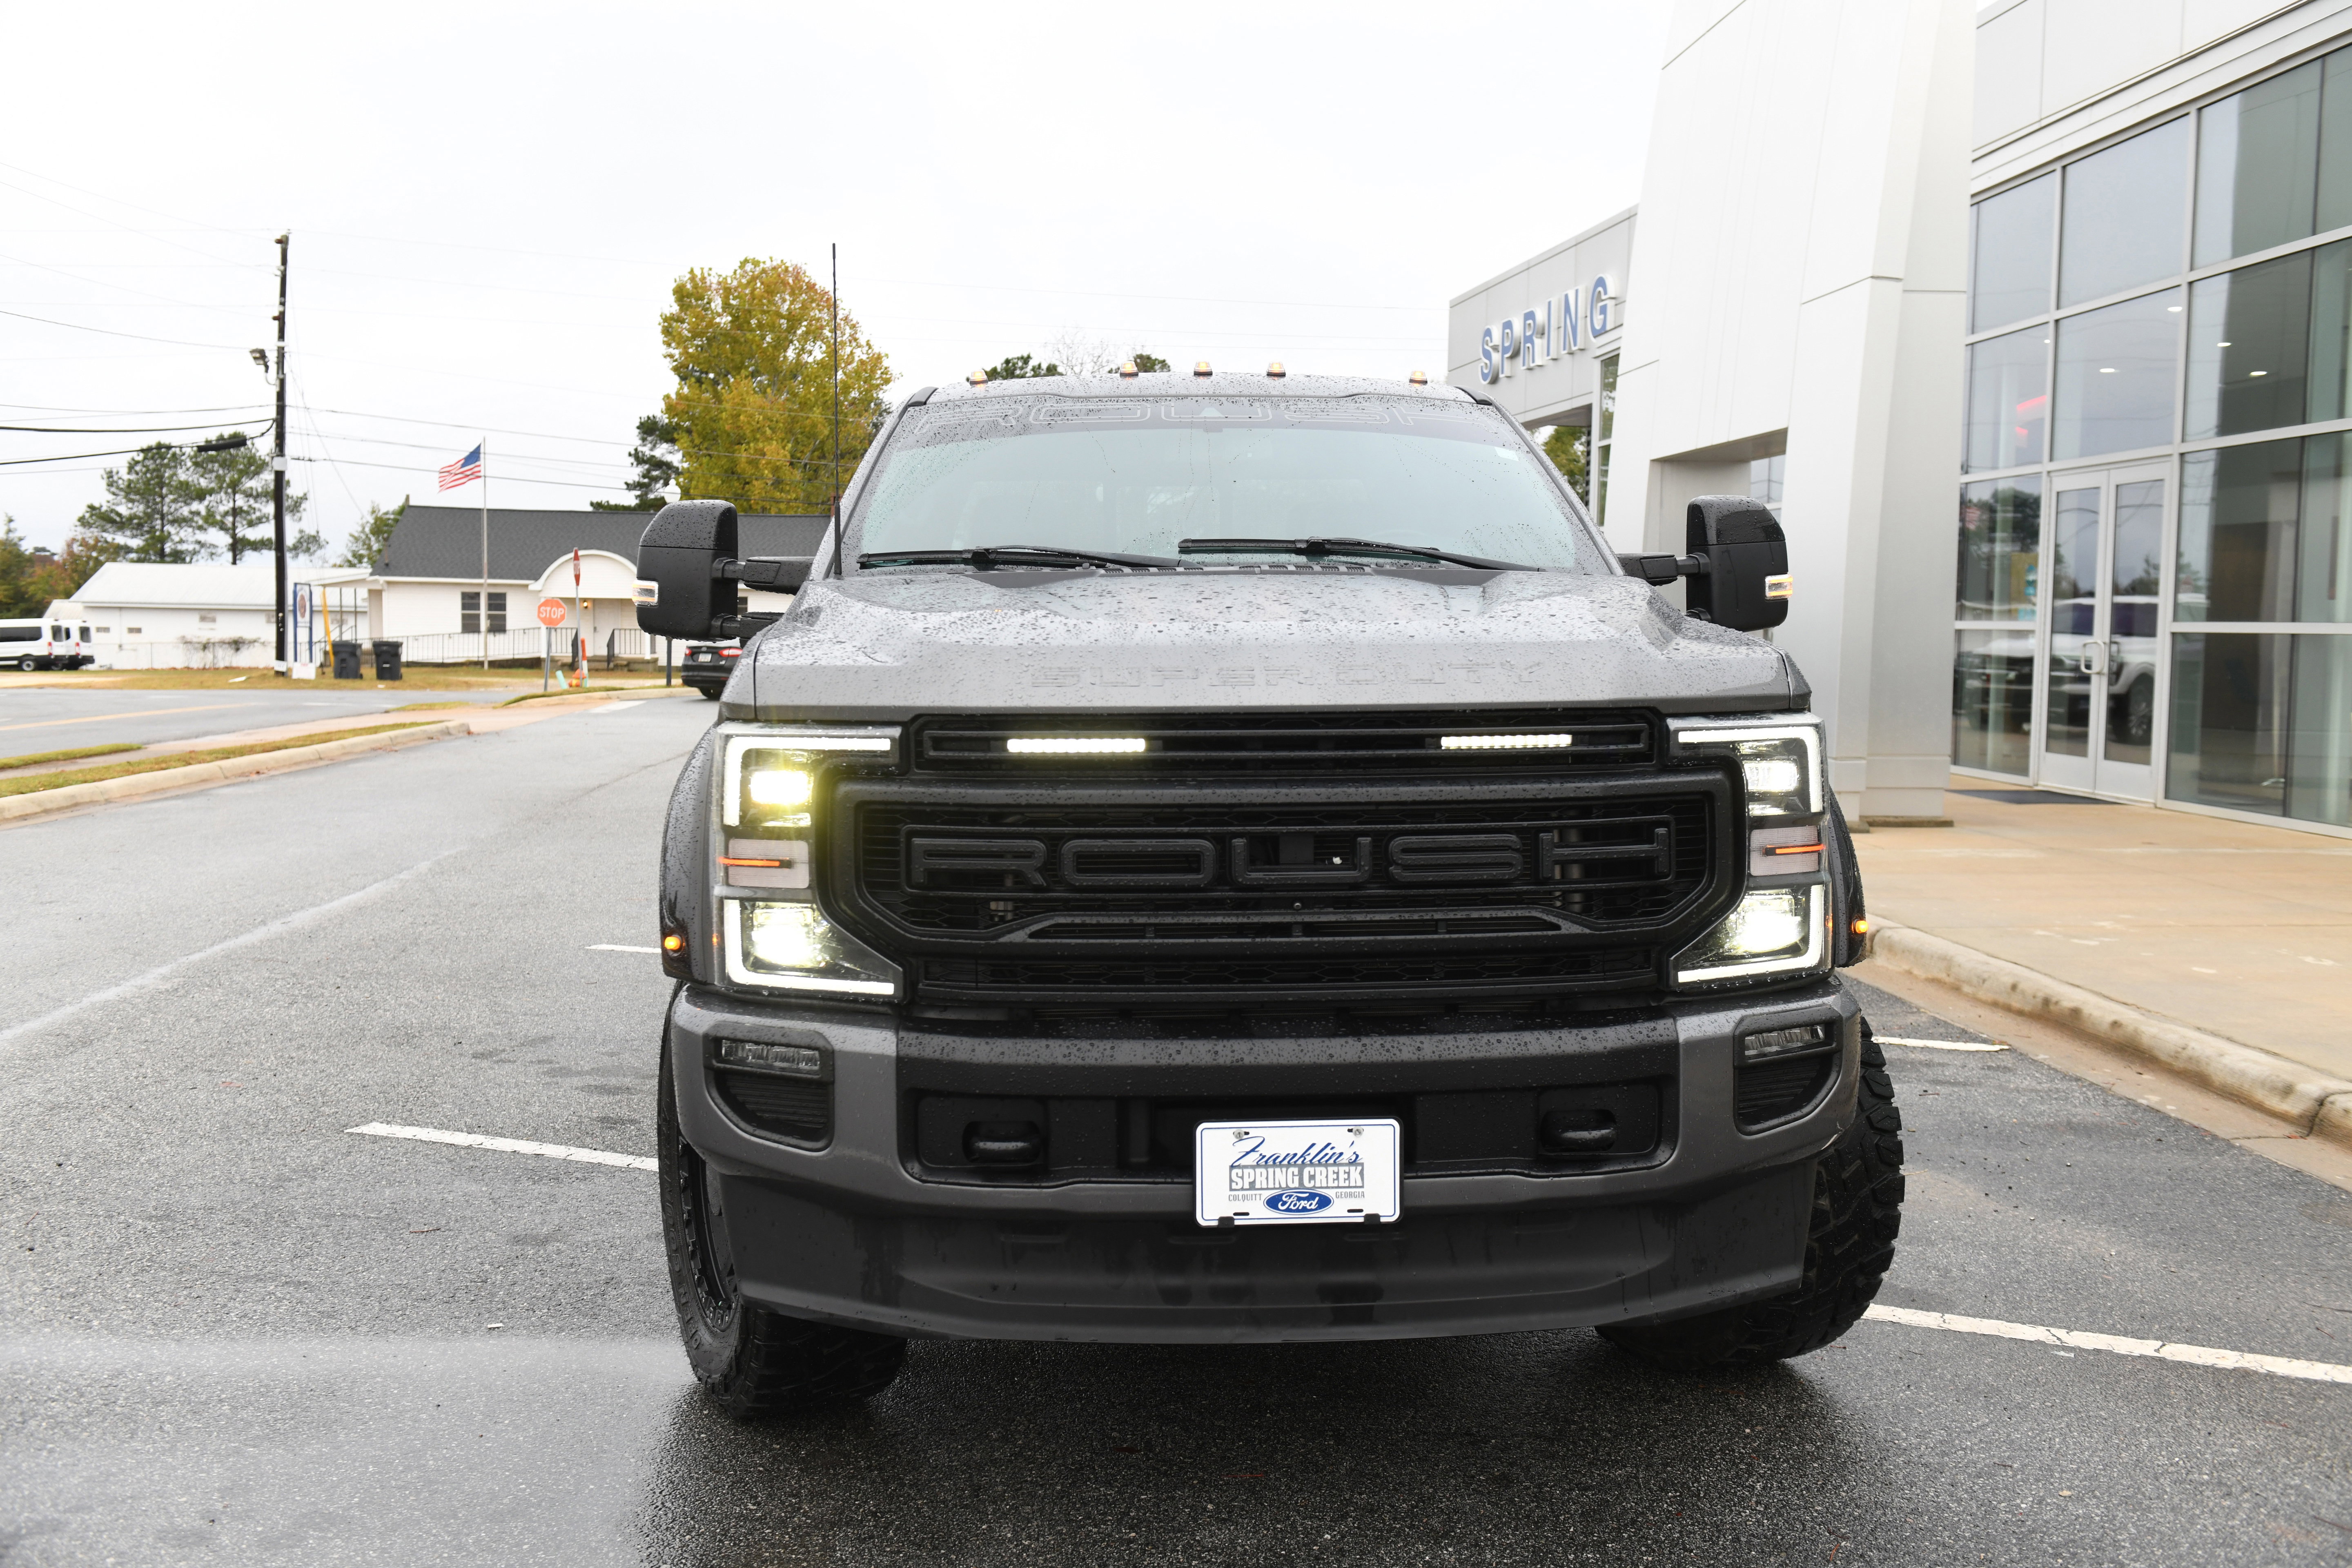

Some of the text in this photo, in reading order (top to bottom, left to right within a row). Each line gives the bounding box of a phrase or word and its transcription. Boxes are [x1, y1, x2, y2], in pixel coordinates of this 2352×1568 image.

[1478, 273, 1616, 384] SPRING
[914, 402, 1499, 434] ROUSH
[539, 606, 564, 619] STOP
[1030, 662, 1544, 688] SUPER DUTY
[911, 827, 1669, 886] ROUSH
[1230, 1136, 1363, 1167] Franklin's
[1231, 1165, 1363, 1189] SPRING CREEK
[1228, 1194, 1263, 1202] COLQUITT
[1278, 1192, 1319, 1210] Ford
